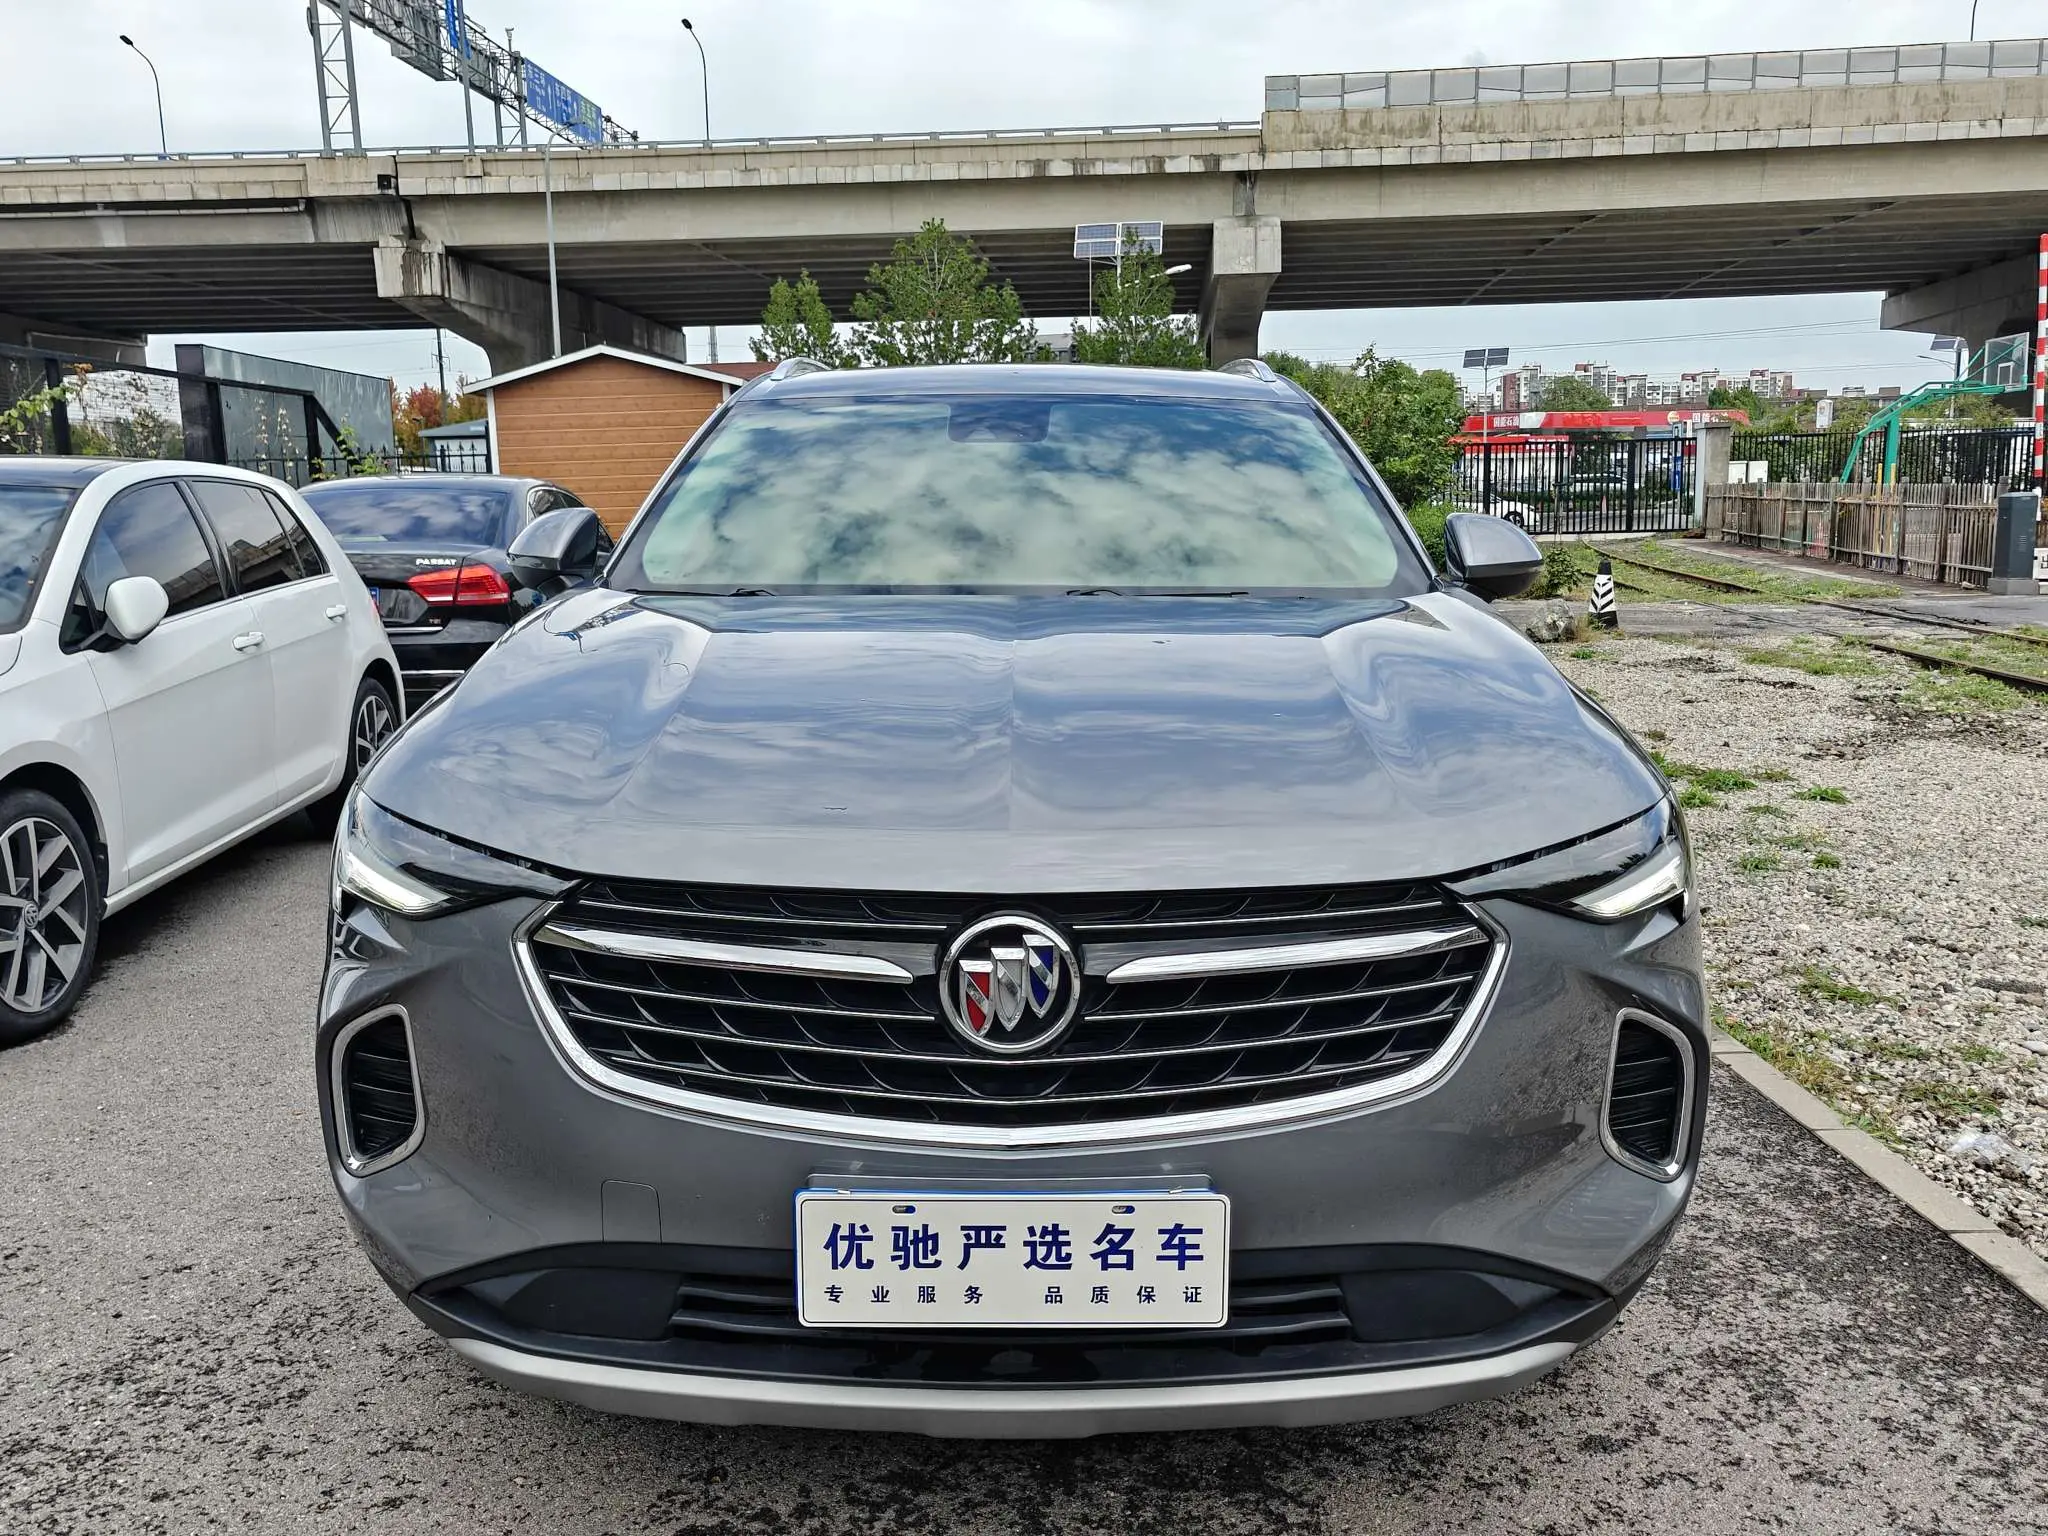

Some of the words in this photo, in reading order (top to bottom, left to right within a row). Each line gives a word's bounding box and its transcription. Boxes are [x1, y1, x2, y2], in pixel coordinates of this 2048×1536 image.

[415, 558, 457, 566] PASSAT
[823, 1222, 1204, 1272] 优驰严选名车
[824, 1285, 984, 1305] 专业服务
[1045, 1285, 1203, 1305] 品质保证
